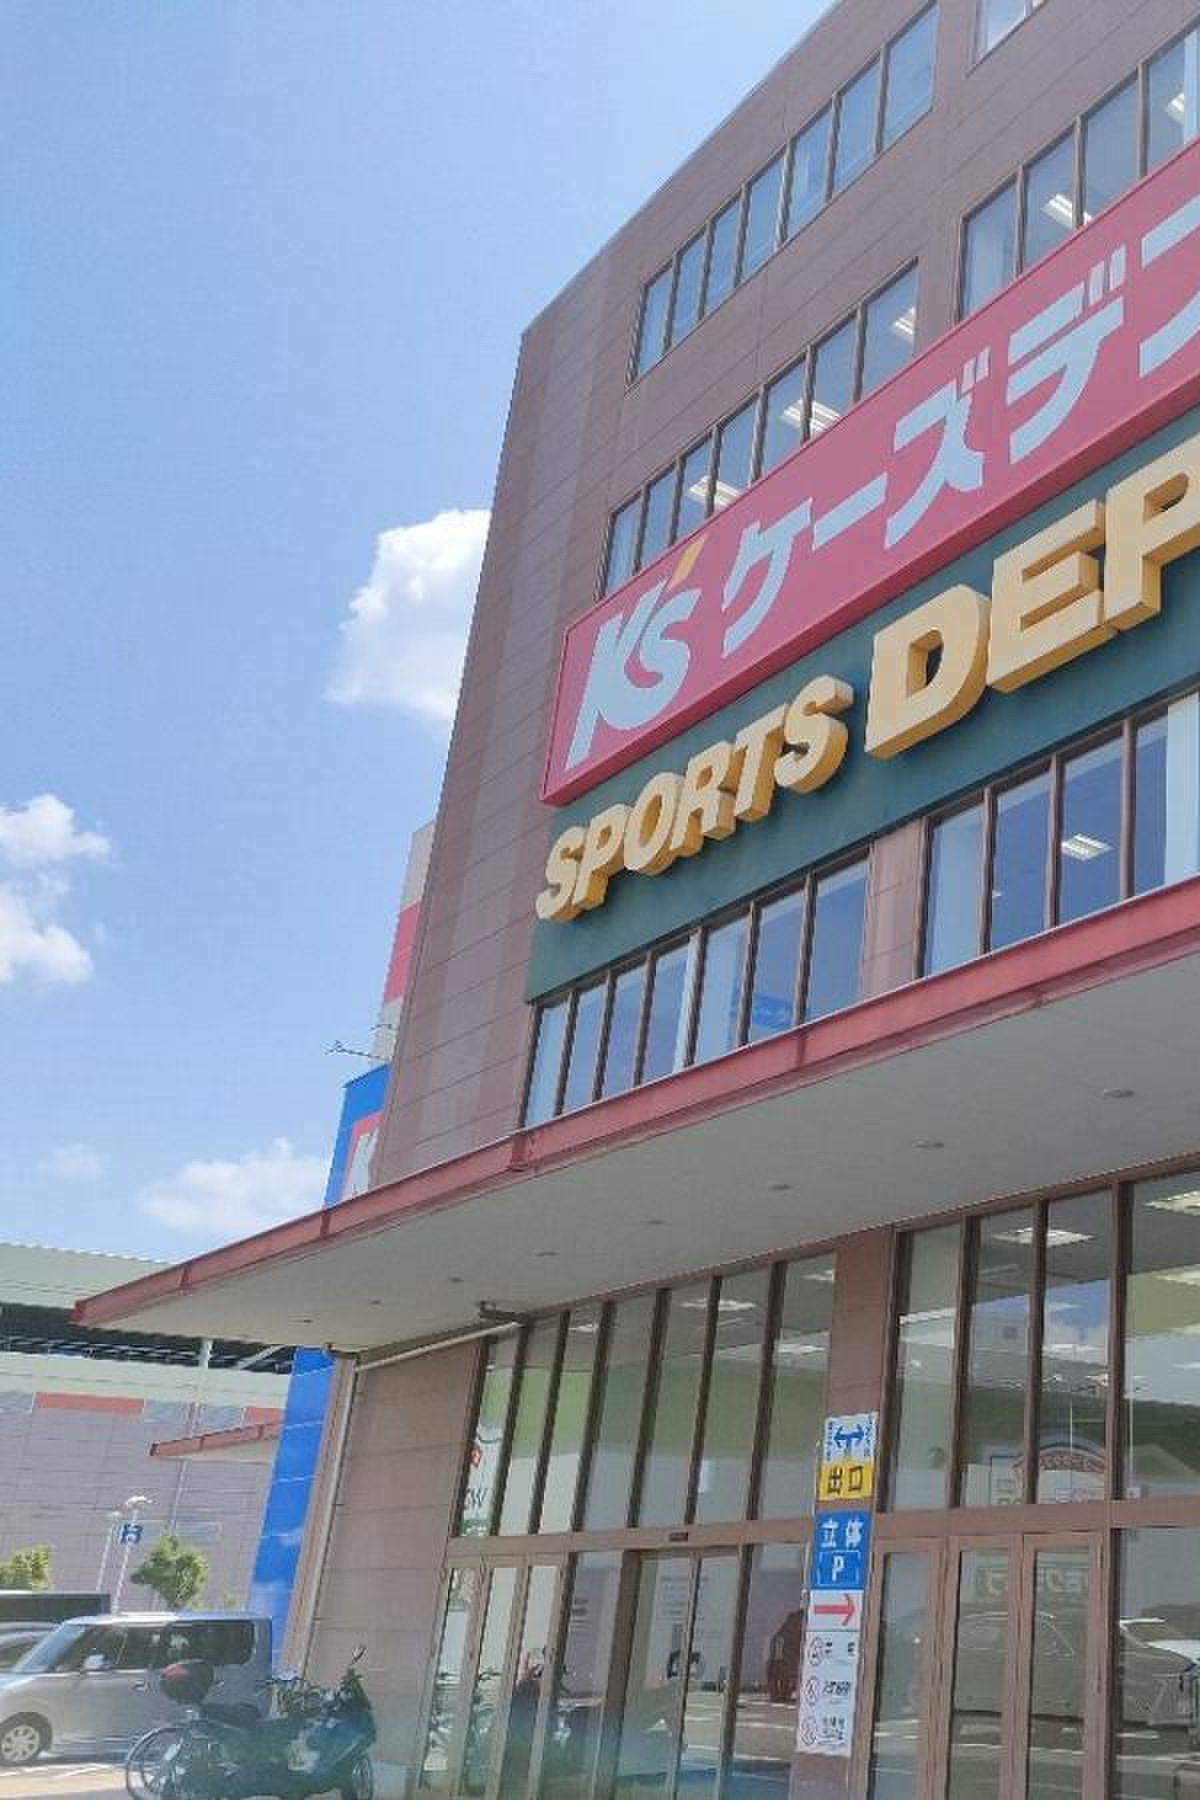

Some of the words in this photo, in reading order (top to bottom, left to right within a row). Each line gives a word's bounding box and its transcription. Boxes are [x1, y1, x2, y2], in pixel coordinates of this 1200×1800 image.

[535, 674, 854, 922] SPORTS
[827, 1465, 864, 1494] 出口
[832, 1555, 845, 1581] P
